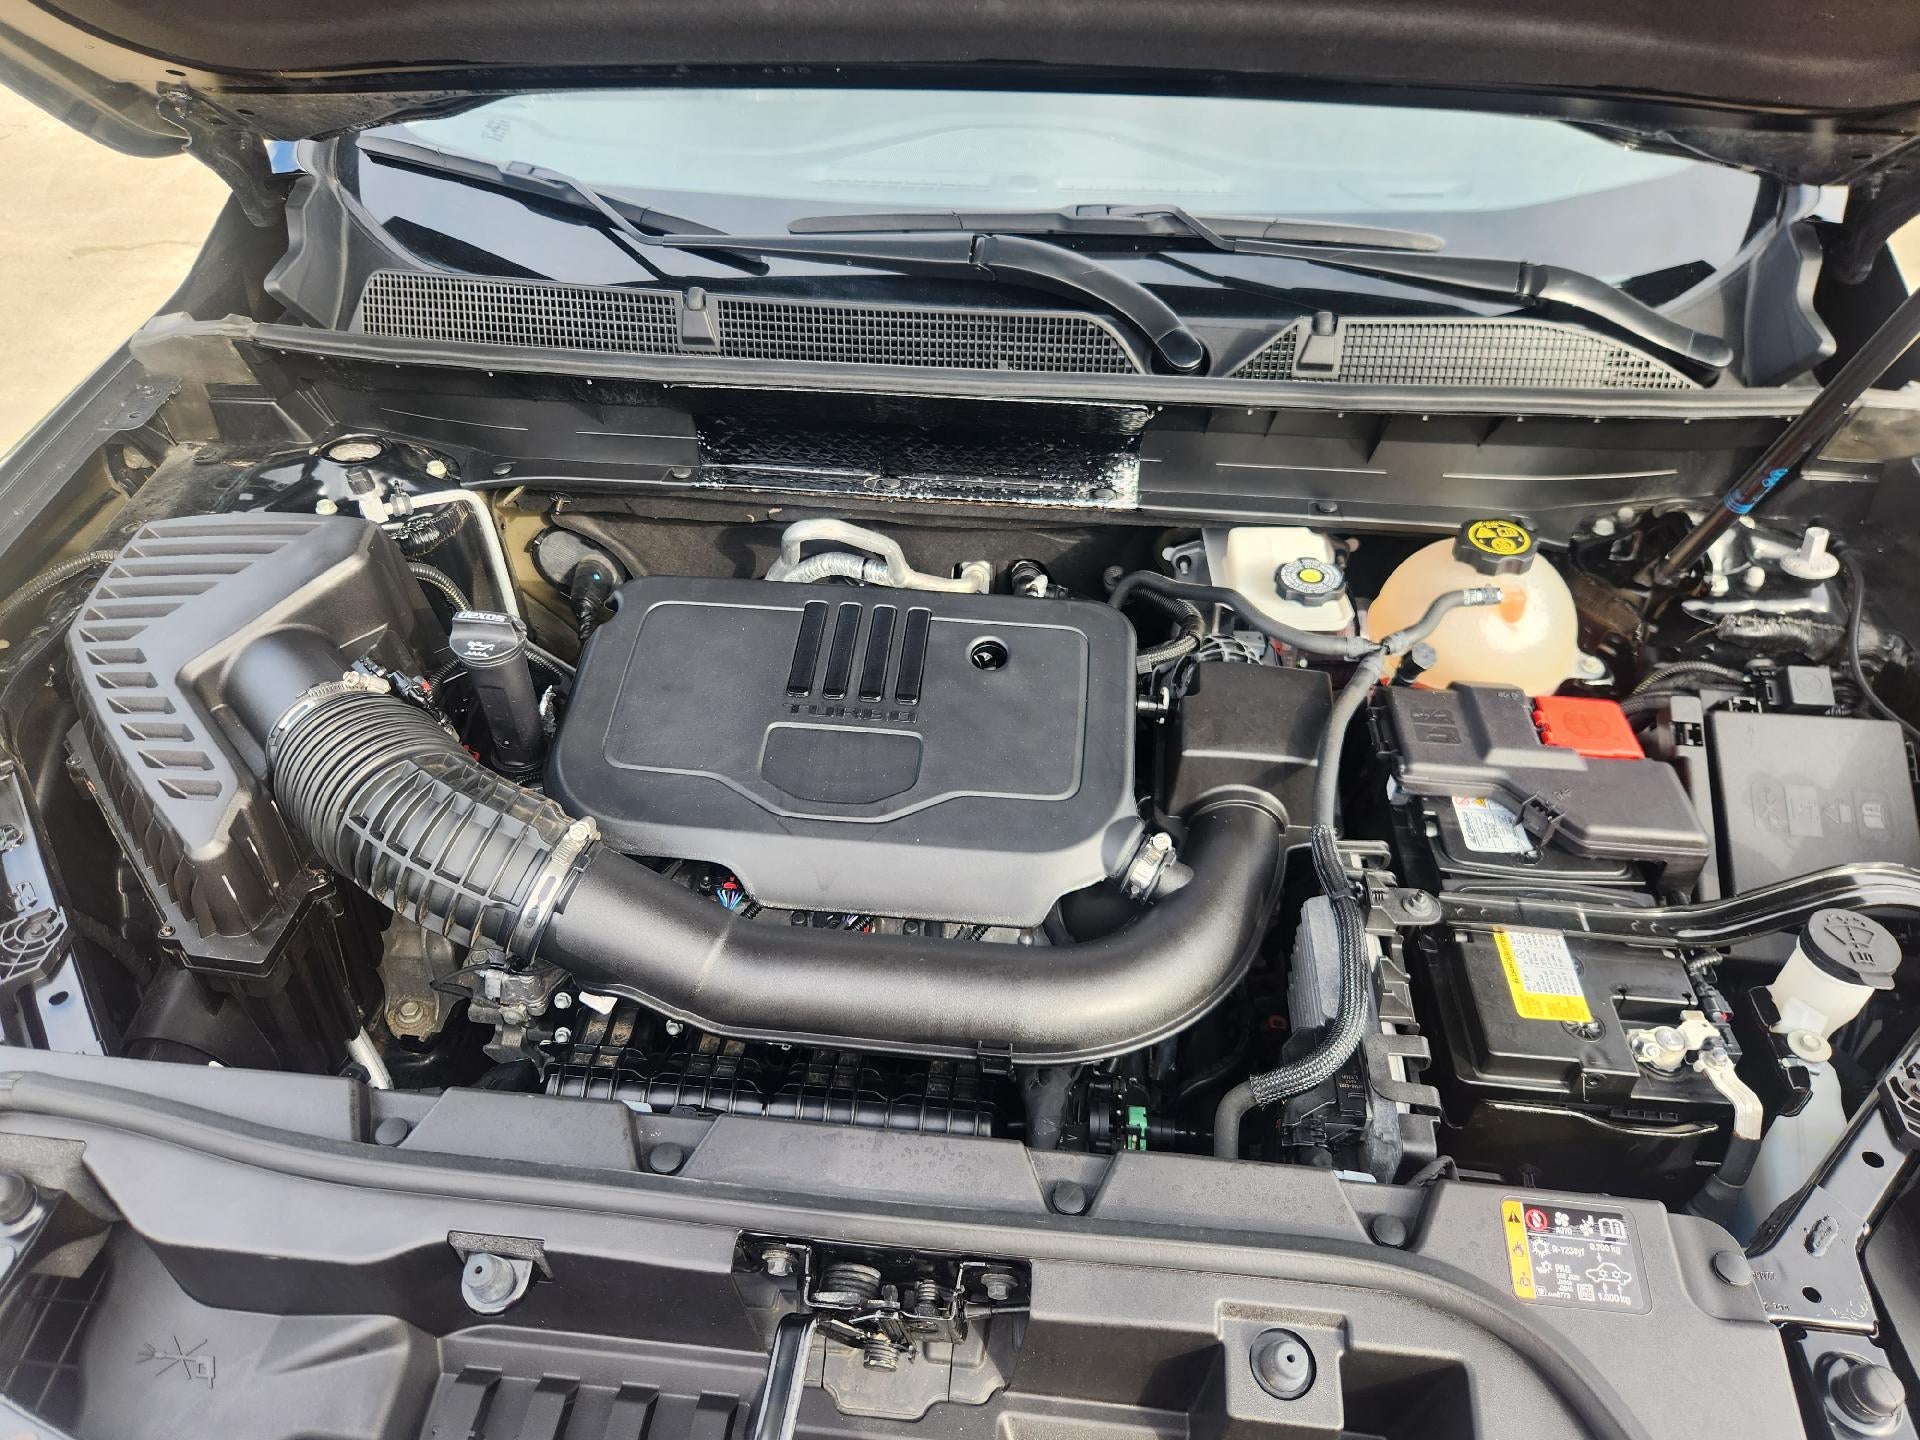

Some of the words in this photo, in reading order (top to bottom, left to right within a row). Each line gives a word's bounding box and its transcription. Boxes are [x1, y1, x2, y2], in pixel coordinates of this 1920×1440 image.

[457, 611, 507, 622] dexos
[783, 703, 917, 724] TURBO
[1555, 1226, 1573, 1236] AUTO
[1611, 1245, 1621, 1255] kg
